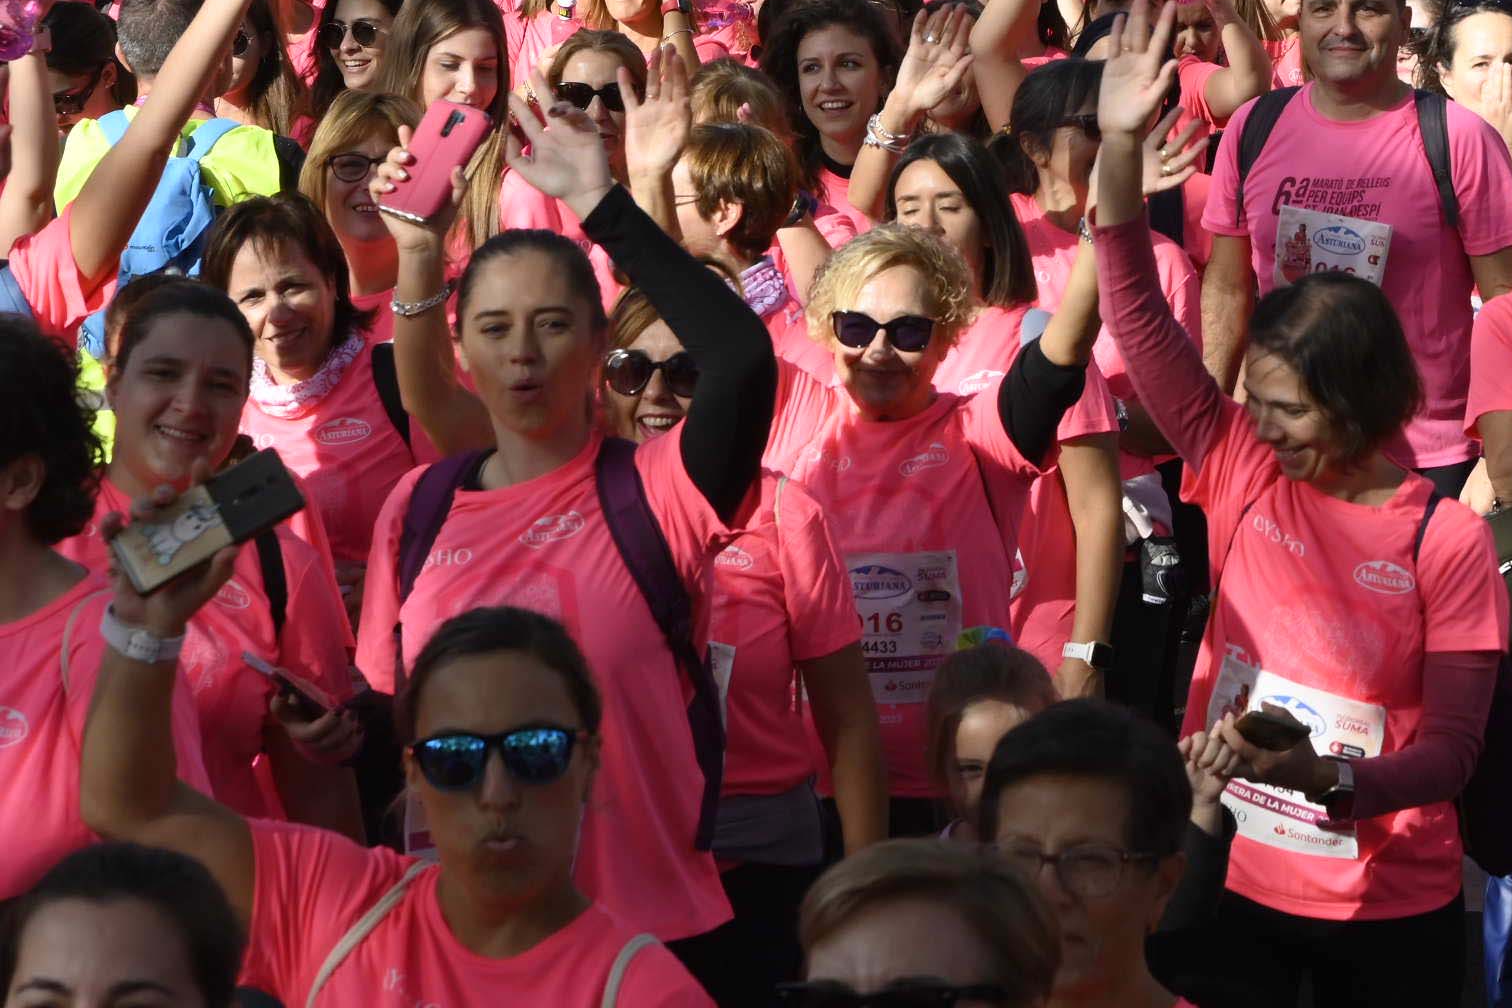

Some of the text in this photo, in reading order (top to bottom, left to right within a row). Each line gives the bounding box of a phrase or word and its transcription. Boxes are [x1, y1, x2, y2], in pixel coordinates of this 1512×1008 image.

[1306, 189, 1366, 205] PER EQUIPS
[853, 581, 907, 592] STURIANA
[1334, 720, 1370, 737] SUMA
[1251, 792, 1266, 804] DE
[1267, 798, 1281, 811] LA
[1281, 803, 1316, 822] MUJER
[1286, 826, 1344, 848] Santander
